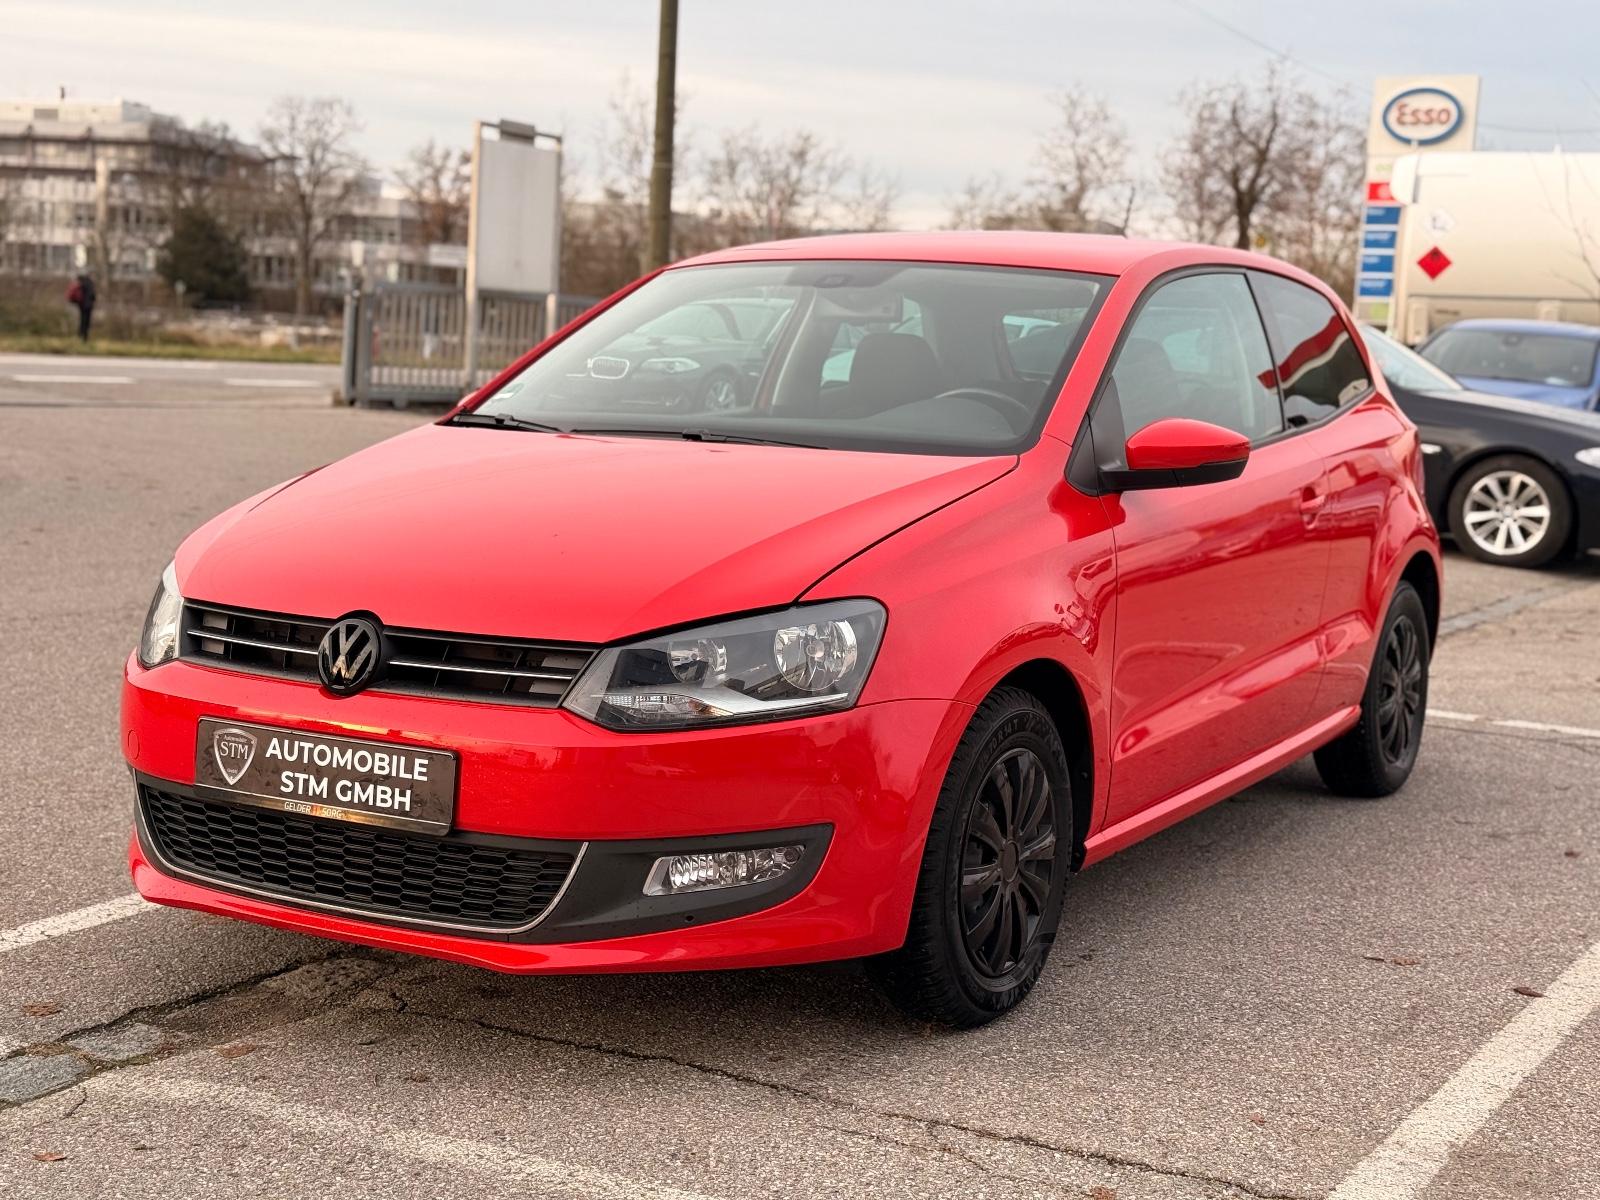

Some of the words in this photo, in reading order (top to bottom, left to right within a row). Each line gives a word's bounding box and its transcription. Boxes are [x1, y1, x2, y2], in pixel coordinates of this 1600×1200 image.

[1396, 101, 1452, 126] Esso
[220, 741, 248, 760] STM
[265, 737, 429, 782] AUTOMOBILE
[280, 771, 329, 799] STM
[335, 779, 412, 812] GMBH
[284, 801, 312, 815] GELDER
[322, 807, 342, 819] SORG
